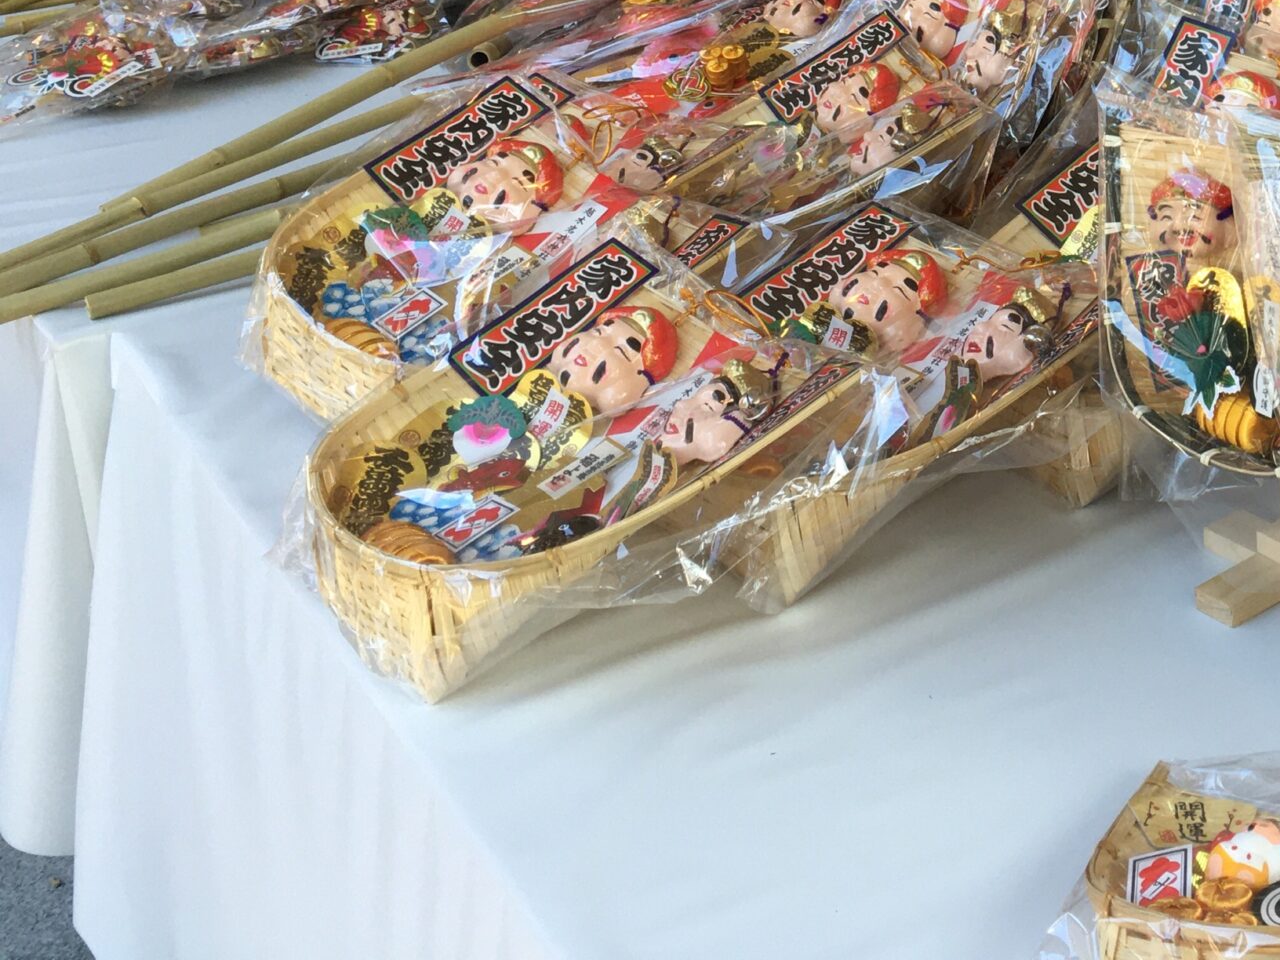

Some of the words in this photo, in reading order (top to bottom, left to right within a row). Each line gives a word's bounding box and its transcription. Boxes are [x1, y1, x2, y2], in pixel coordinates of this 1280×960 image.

[770, 17, 902, 117] 家内安全
[380, 90, 532, 201] 家内安全
[461, 250, 639, 393] 家内安全
[752, 211, 900, 326] 家内安全
[1173, 800, 1209, 842] 開運
